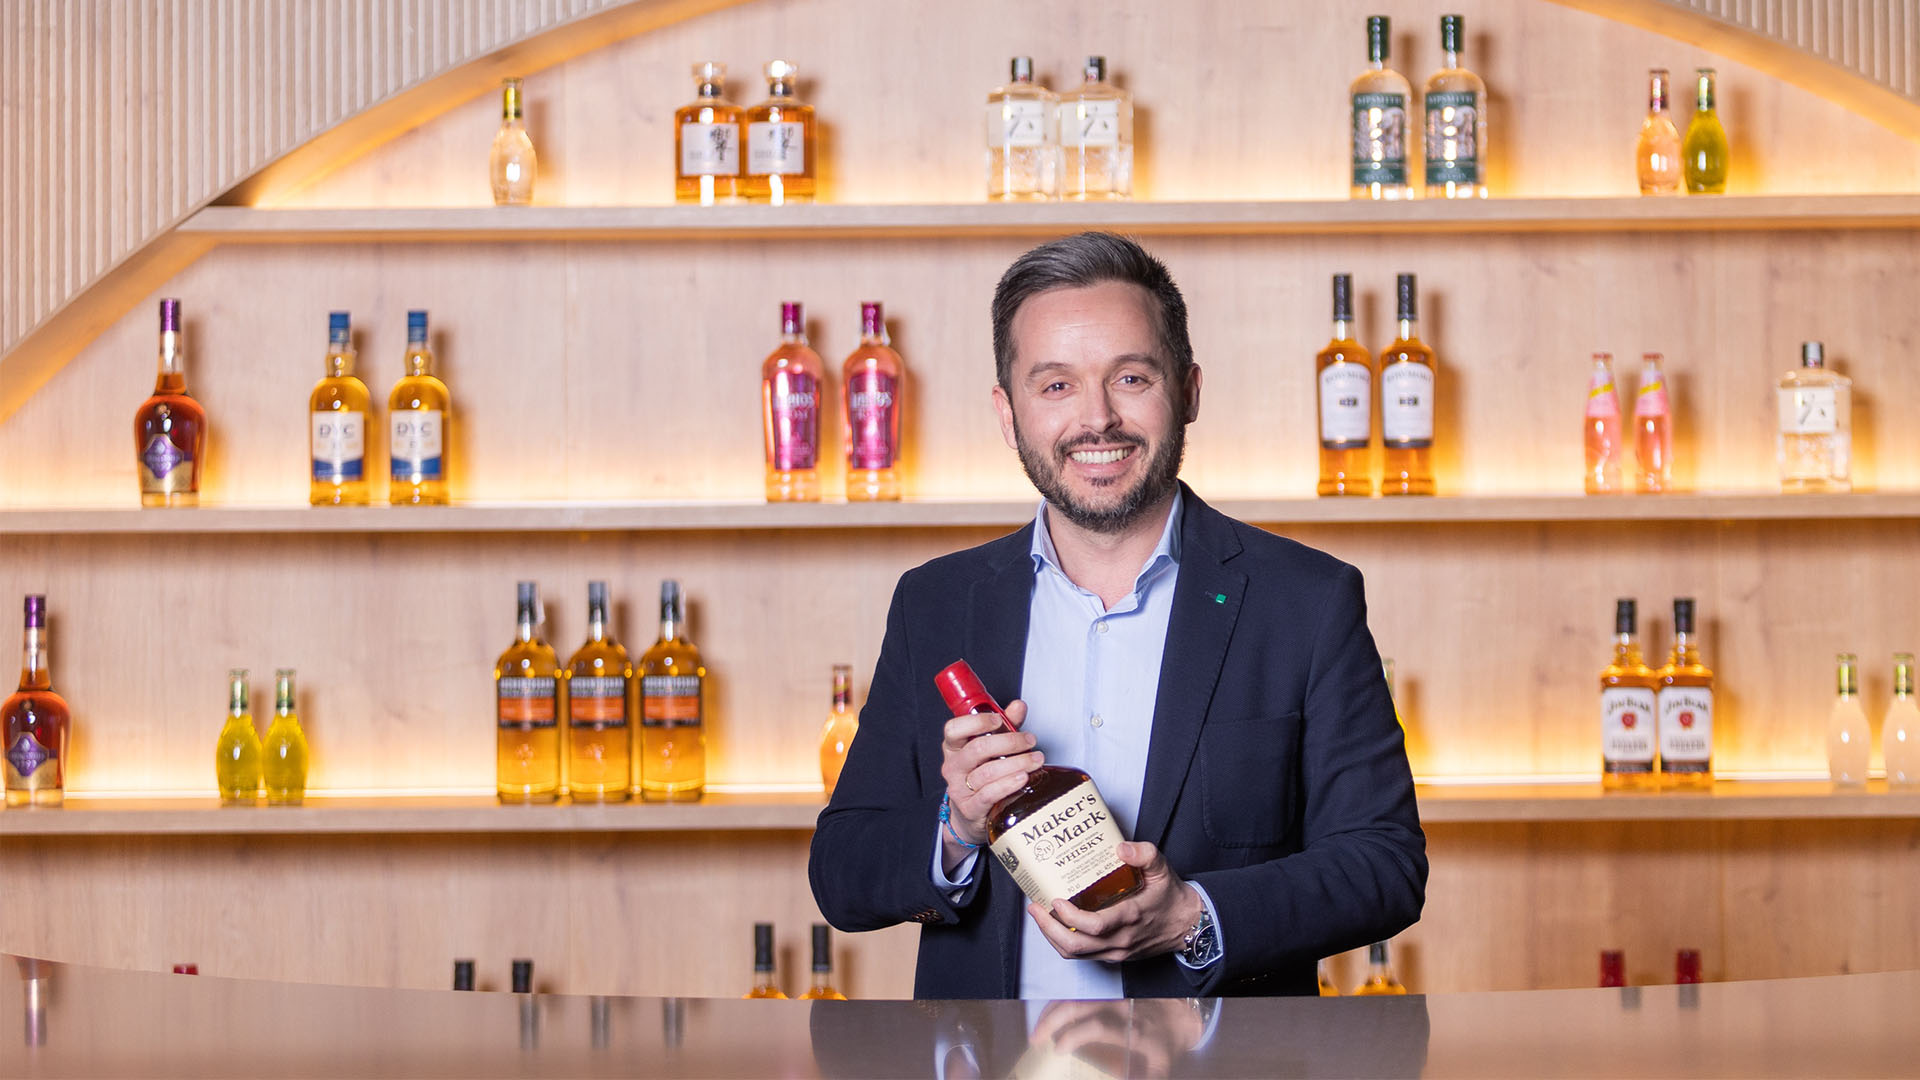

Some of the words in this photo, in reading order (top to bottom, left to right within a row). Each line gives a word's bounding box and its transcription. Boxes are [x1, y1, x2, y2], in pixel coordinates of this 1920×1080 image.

[1021, 793, 1098, 846] Maker's
[1052, 810, 1107, 849] Mark
[1054, 832, 1106, 868] WHISKY
